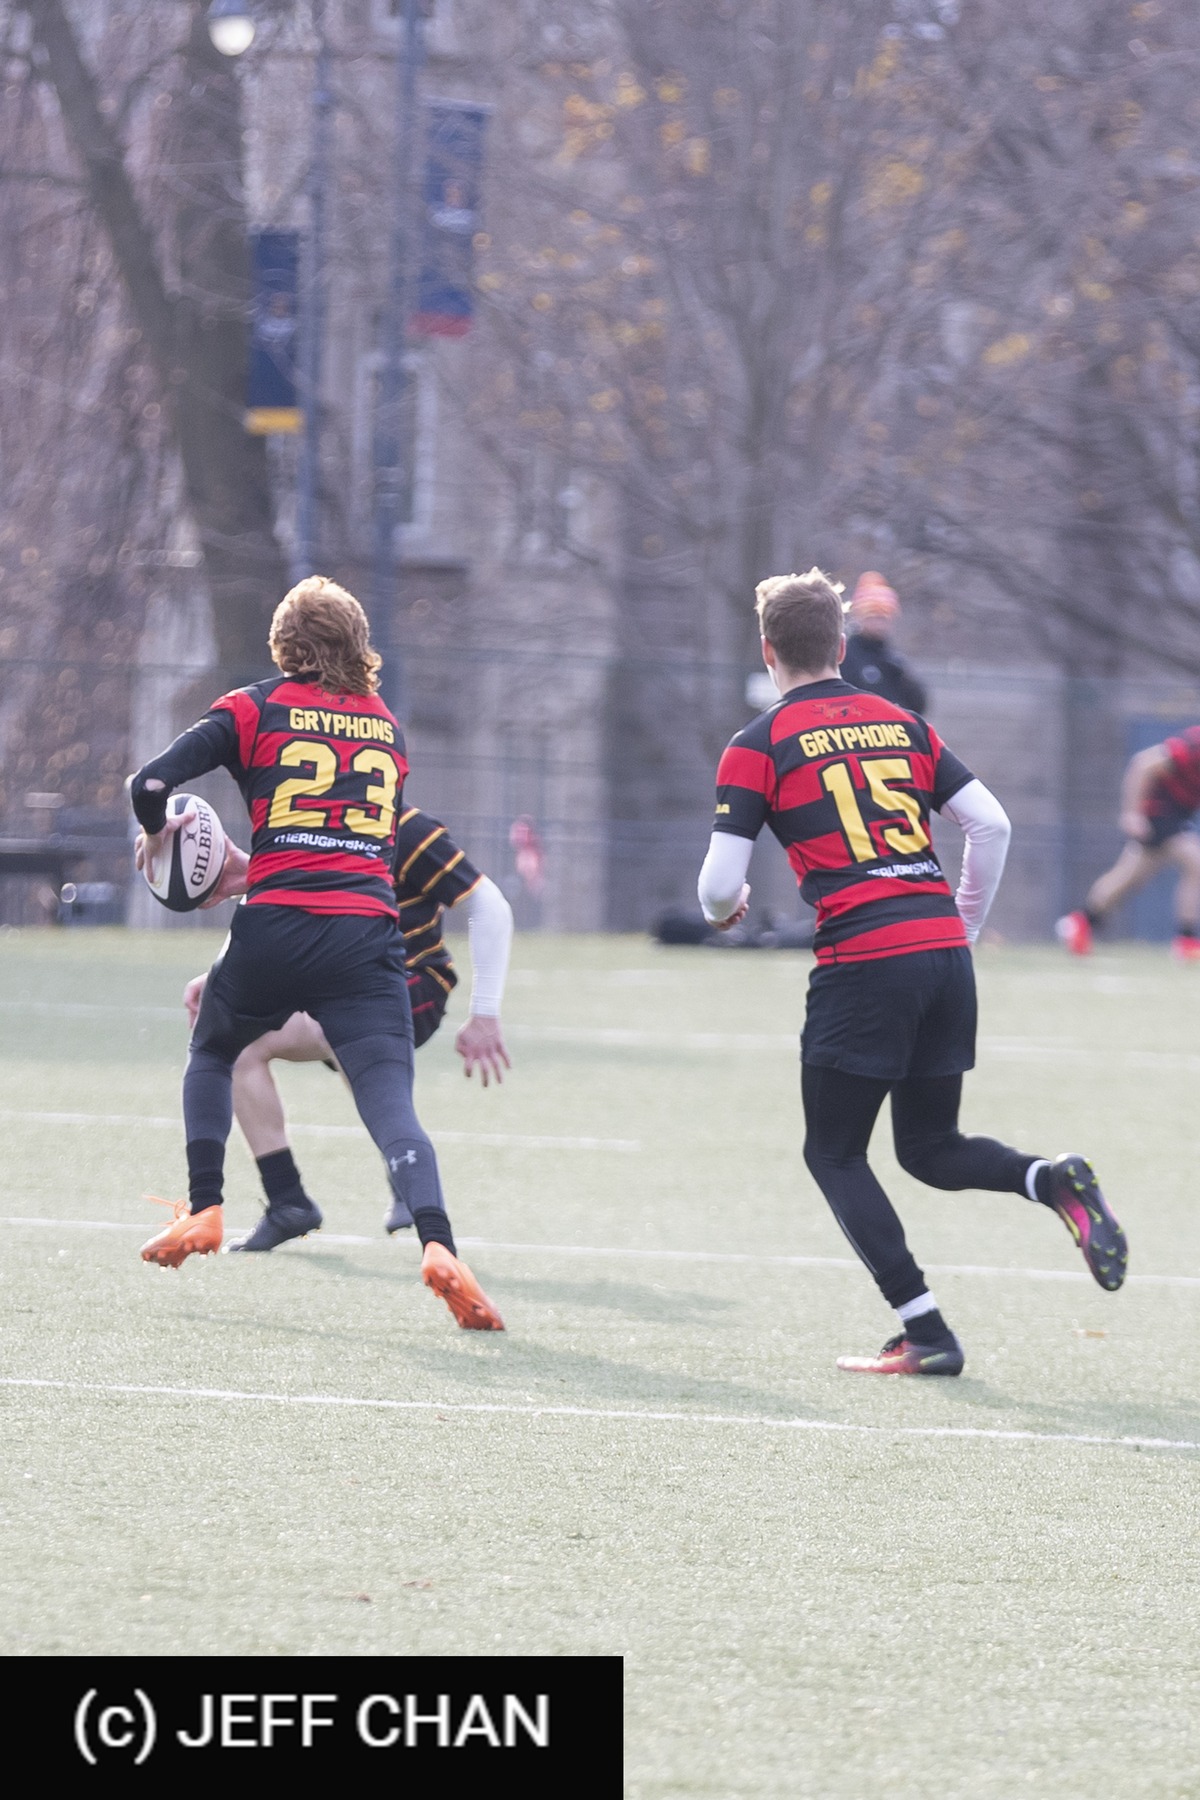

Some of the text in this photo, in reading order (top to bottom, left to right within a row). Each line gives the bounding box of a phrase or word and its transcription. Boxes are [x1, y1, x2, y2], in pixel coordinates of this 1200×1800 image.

[289, 707, 394, 744] GRYPHONS
[799, 723, 912, 758] GRYPHONS
[268, 740, 399, 839] 23
[822, 758, 930, 863] 15
[190, 801, 213, 887] GILBERT
